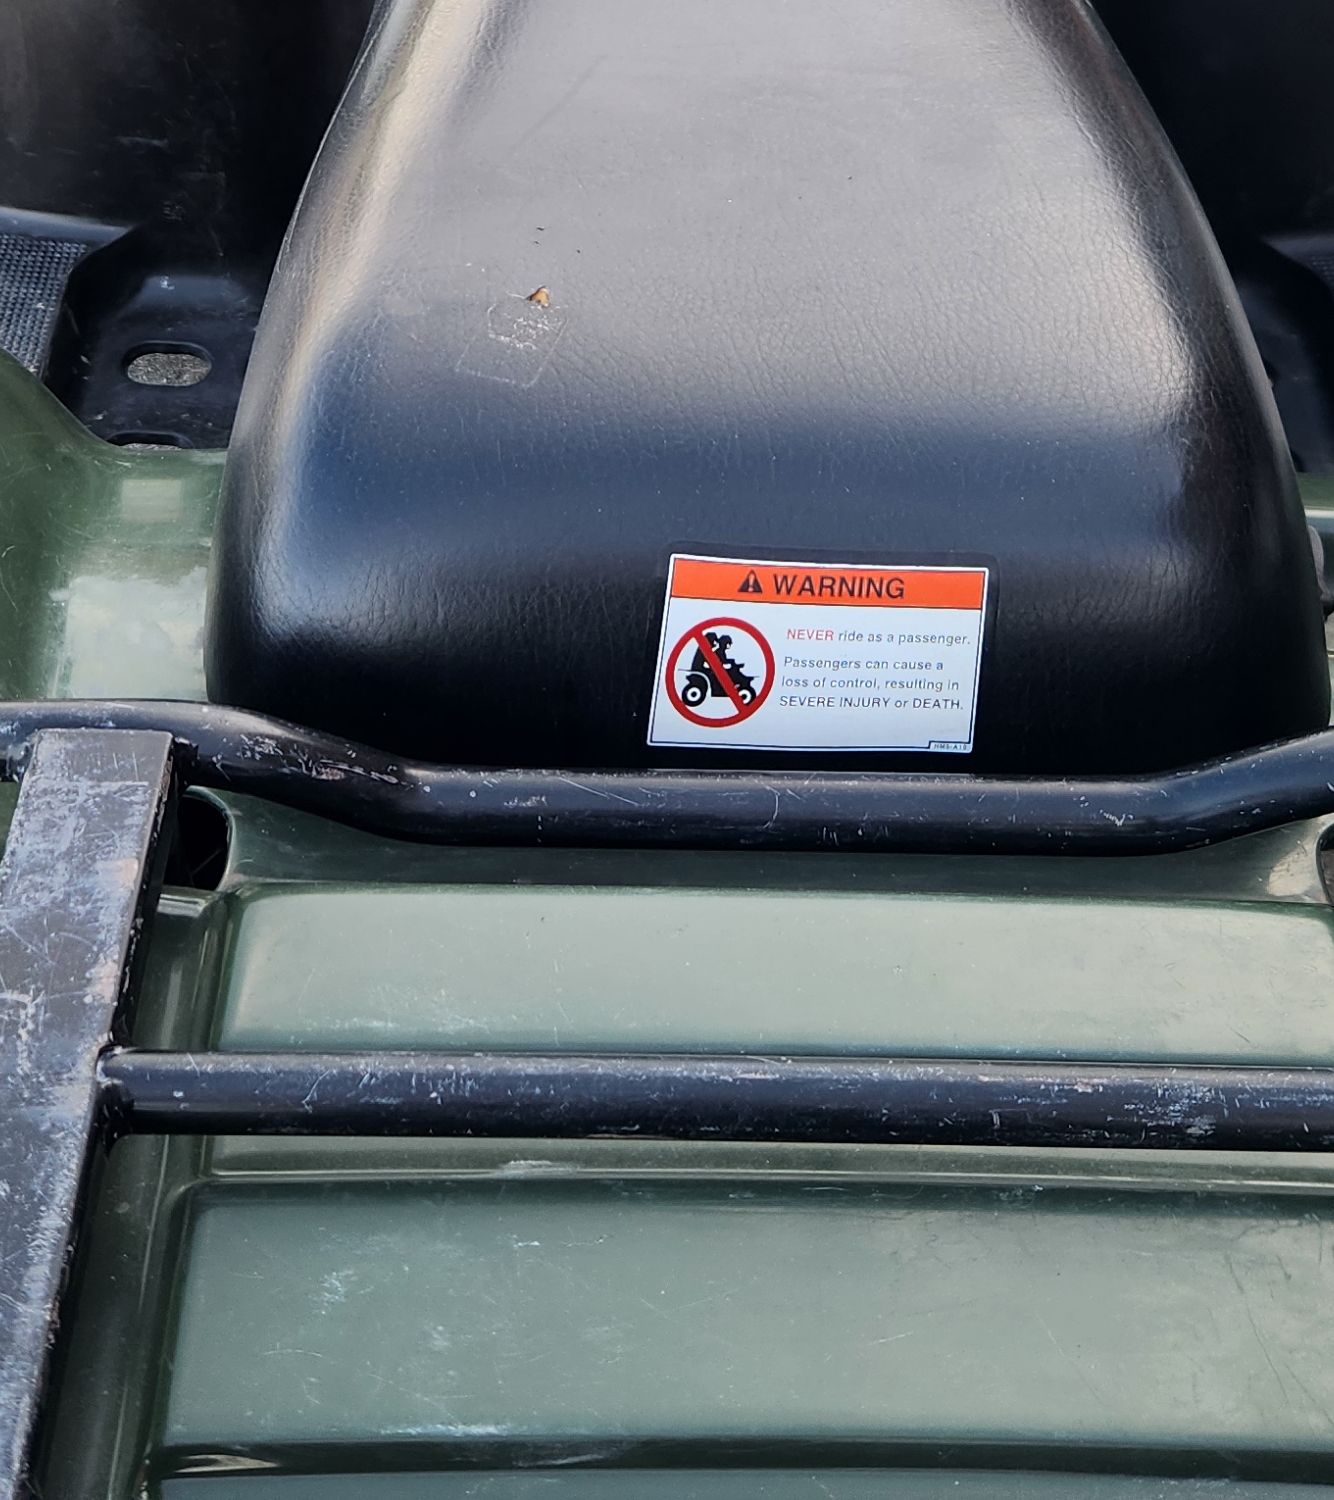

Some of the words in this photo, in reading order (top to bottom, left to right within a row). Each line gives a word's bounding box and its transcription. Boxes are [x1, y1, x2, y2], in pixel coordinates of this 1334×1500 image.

[773, 574, 905, 599] WARNING
[787, 629, 834, 642] NEVER
[838, 630, 863, 642] ride
[868, 633, 882, 643] as
[887, 634, 895, 643] a
[898, 634, 970, 647] passenger.
[784, 657, 861, 671] Passengers
[865, 660, 889, 670] can
[893, 660, 933, 671] cause
[936, 661, 943, 671] a
[781, 676, 808, 688] loss
[813, 677, 826, 688] of
[830, 677, 880, 691] control,
[885, 678, 943, 692] resulting
[948, 680, 959, 690] in
[779, 696, 835, 708] SEVERE
[839, 697, 890, 709] INJURY
[895, 699, 908, 709] or
[912, 698, 963, 710] DEATH.
